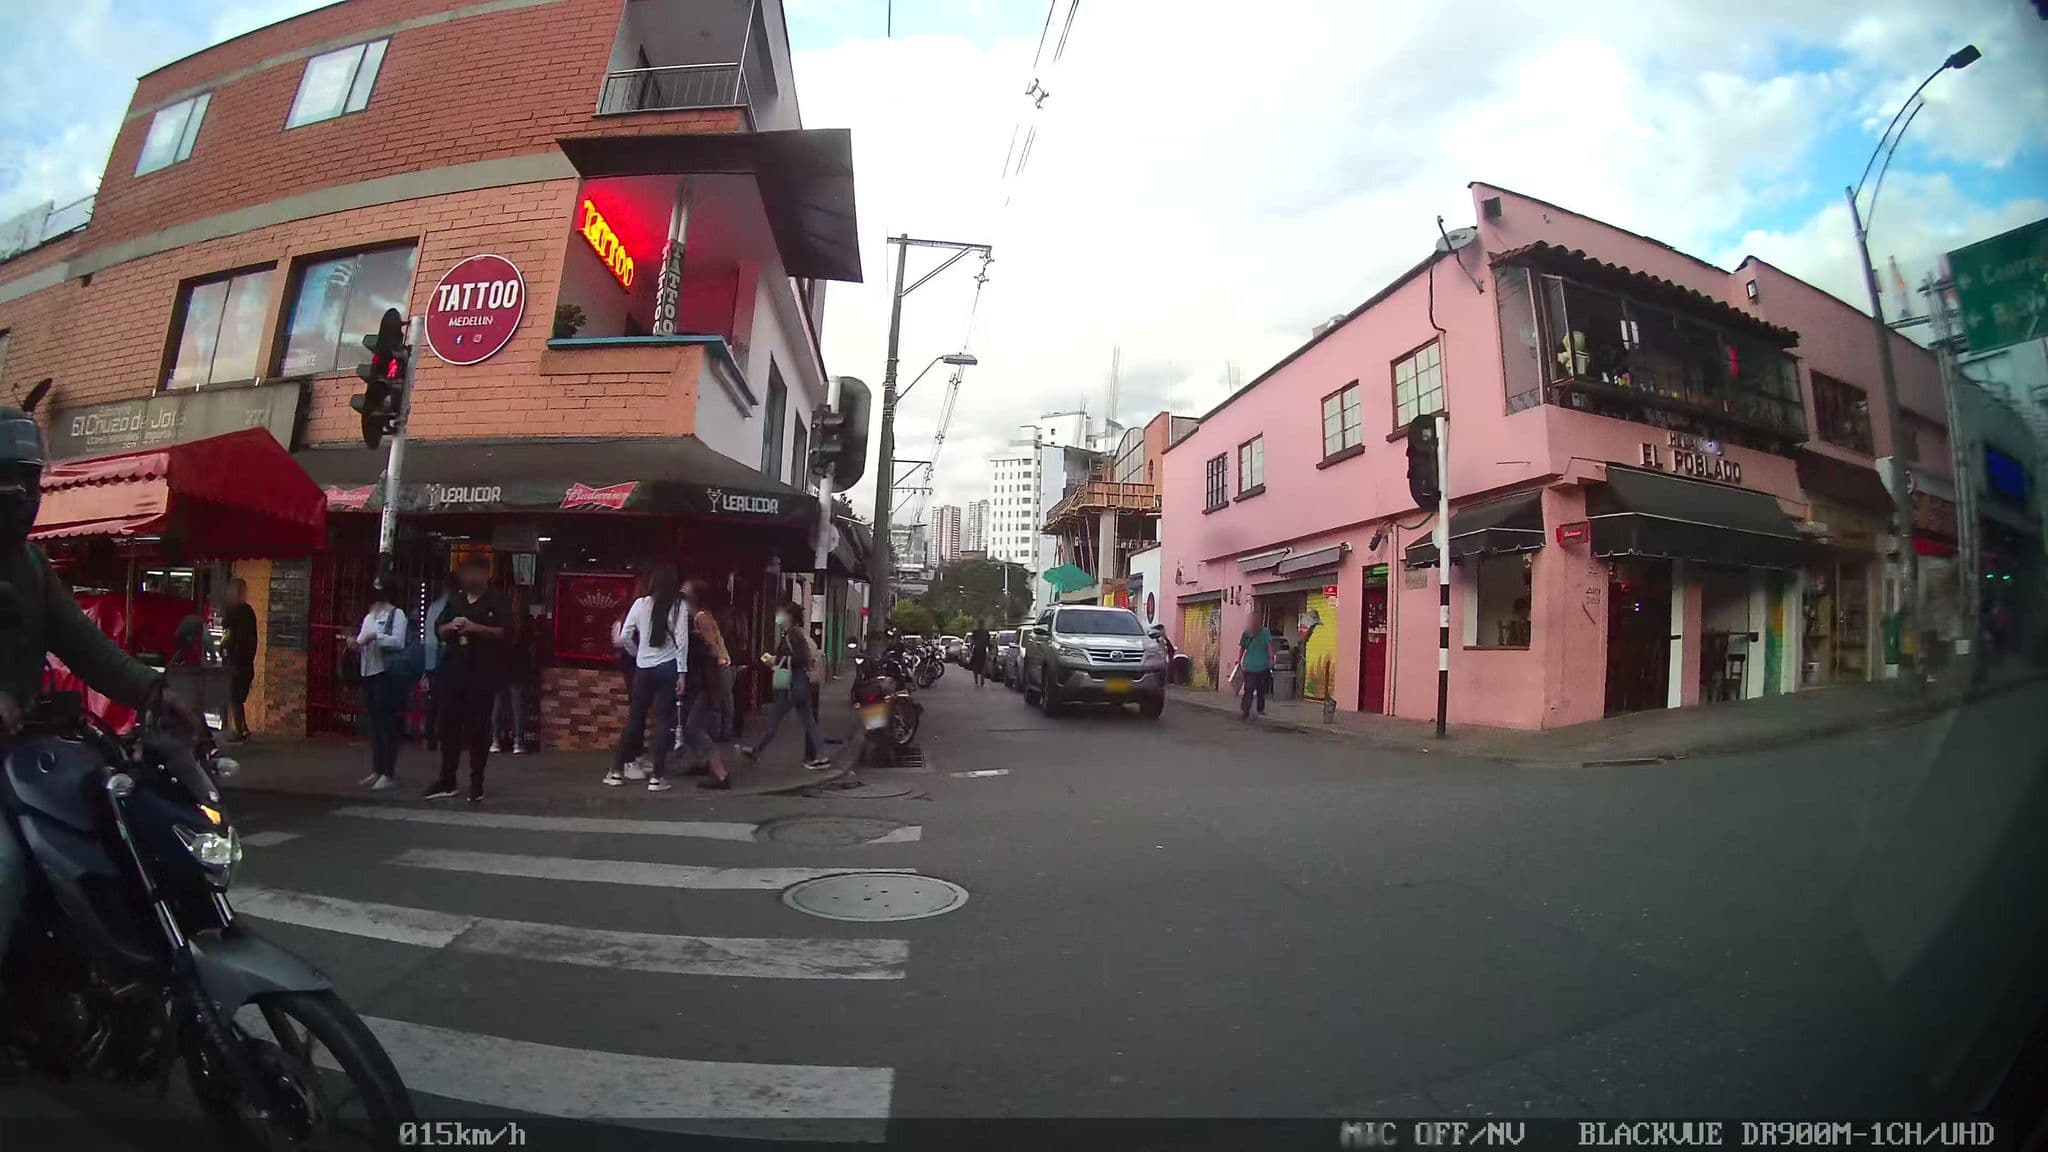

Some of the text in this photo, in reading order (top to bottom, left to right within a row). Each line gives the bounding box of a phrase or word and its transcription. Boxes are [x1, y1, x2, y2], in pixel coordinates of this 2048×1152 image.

[438, 279, 519, 312] TATTOO
[448, 315, 494, 327] MEDELLIN
[1640, 443, 1741, 483] EL POBLADO
